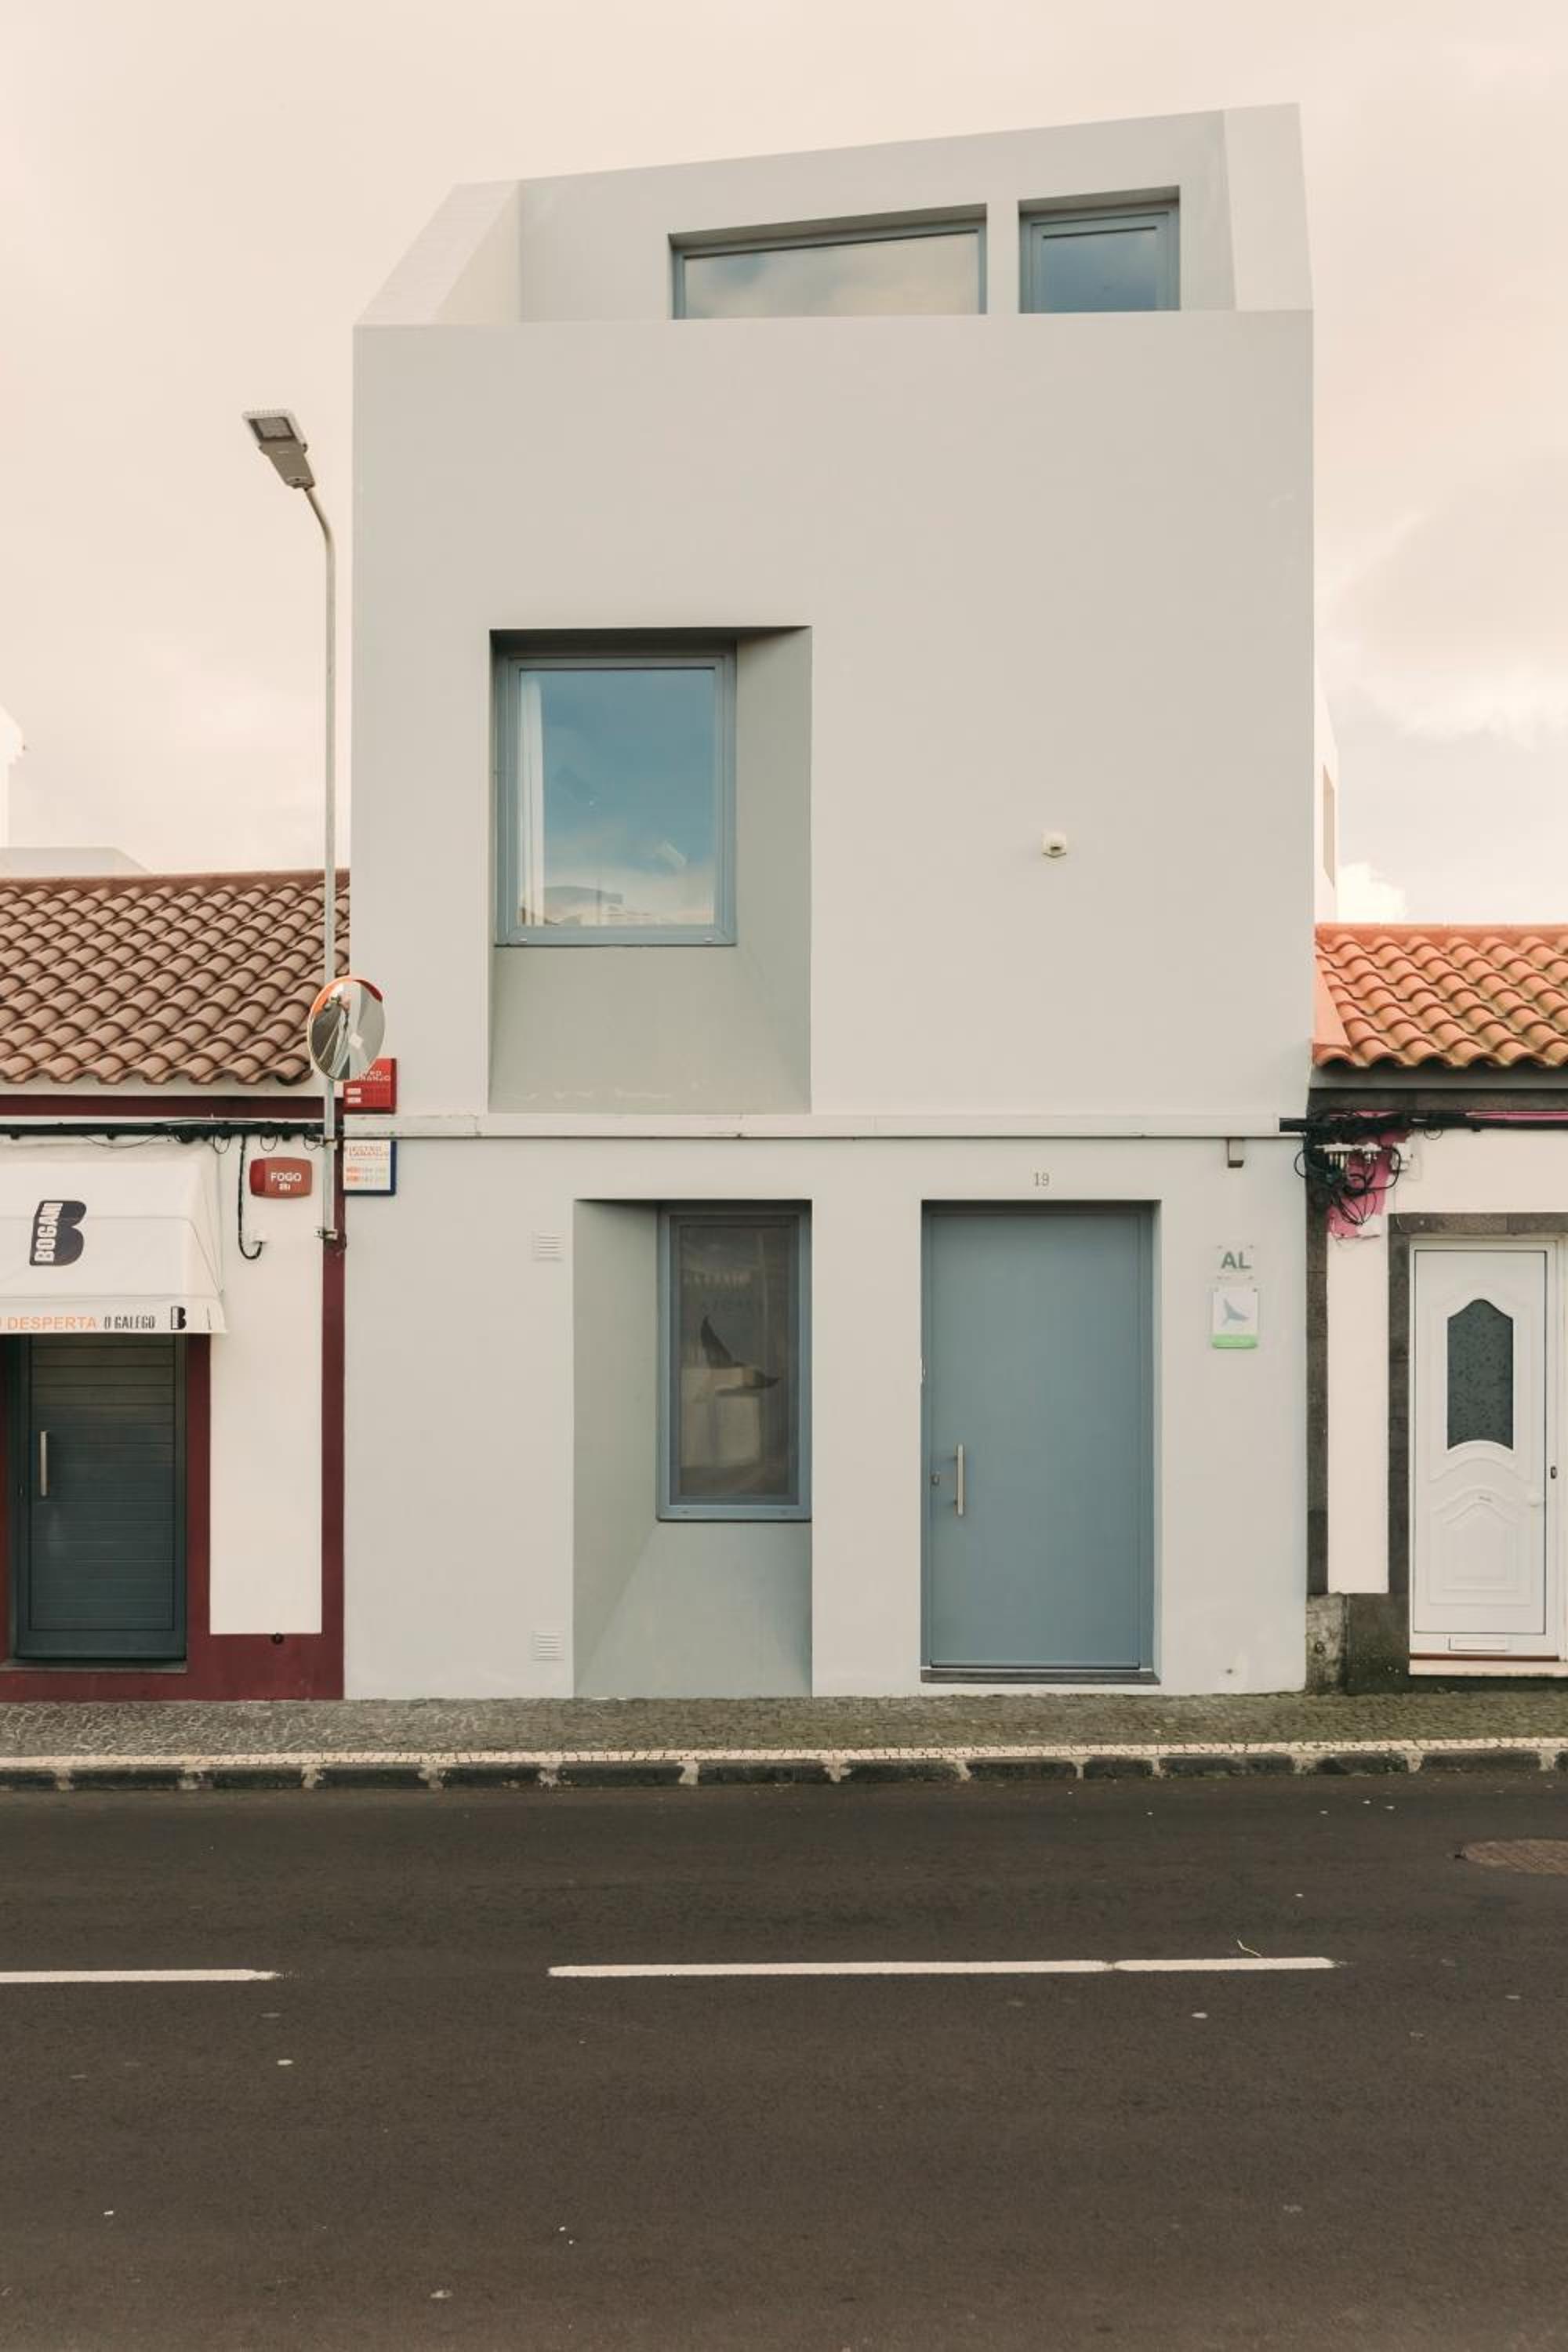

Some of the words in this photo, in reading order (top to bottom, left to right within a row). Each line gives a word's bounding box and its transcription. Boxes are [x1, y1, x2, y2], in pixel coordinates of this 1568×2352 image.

[270, 1172, 302, 1182] FOGO
[1035, 1171, 1050, 1186] 19
[34, 1202, 64, 1263] BOGANI
[1221, 1251, 1252, 1269] AL
[7, 1316, 96, 1330] DESPERTA
[117, 1315, 155, 1330] GALEGO
